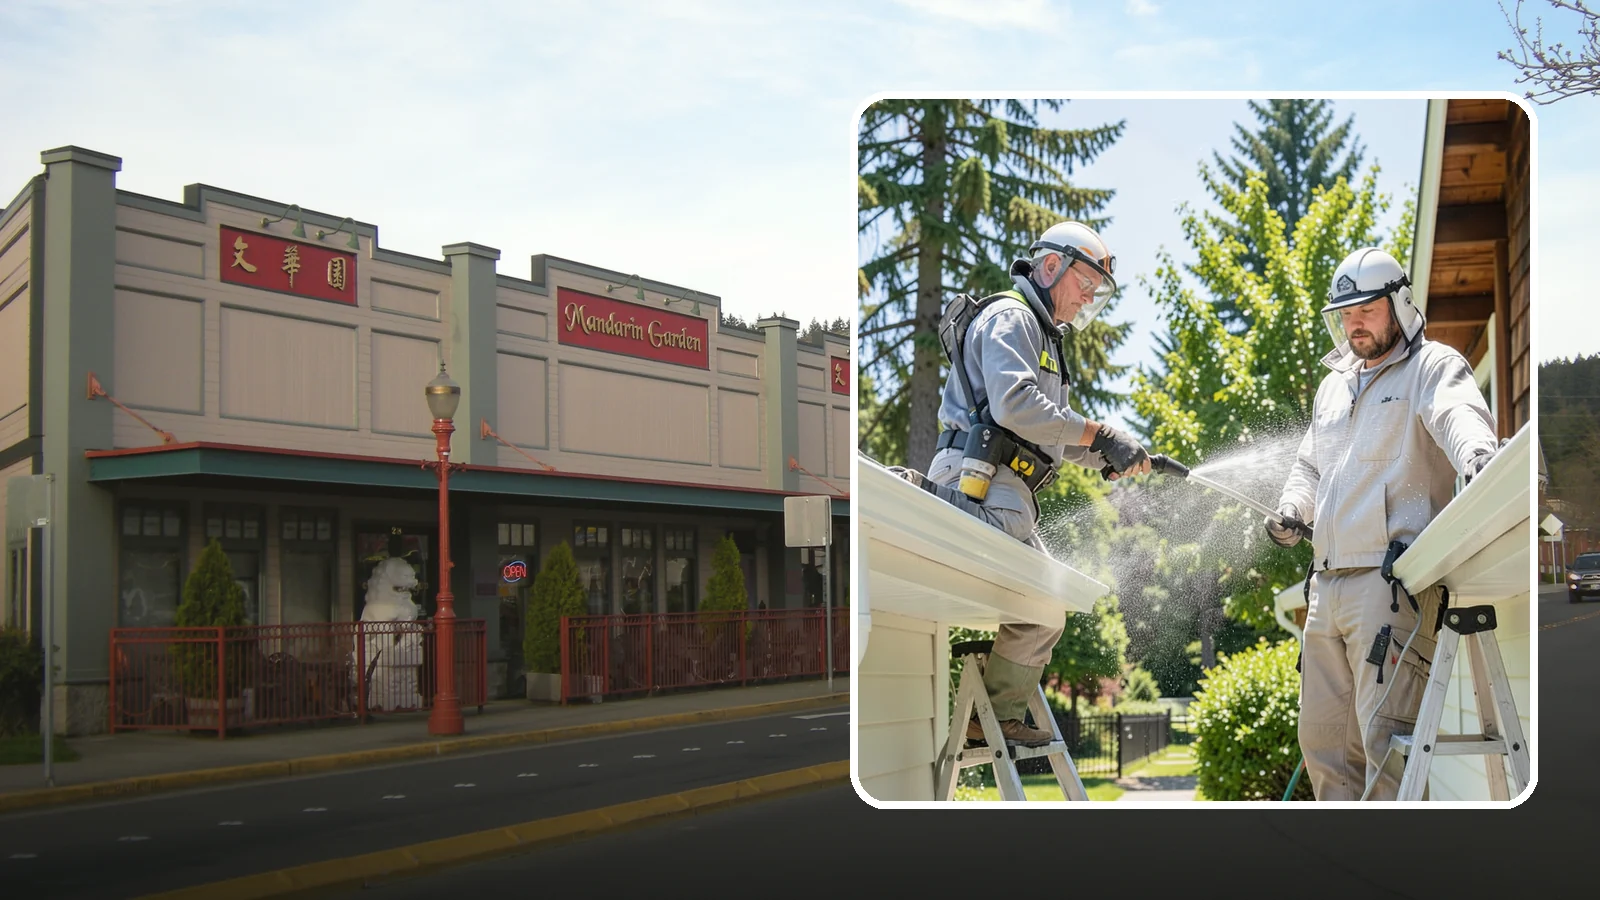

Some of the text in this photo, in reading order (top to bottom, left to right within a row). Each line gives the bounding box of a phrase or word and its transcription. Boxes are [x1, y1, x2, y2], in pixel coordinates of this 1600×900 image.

[230, 235, 346, 291] 文華園
[564, 302, 701, 352] Mandarin Garden
[835, 363, 846, 386] 文
[503, 565, 527, 578] OPEN
